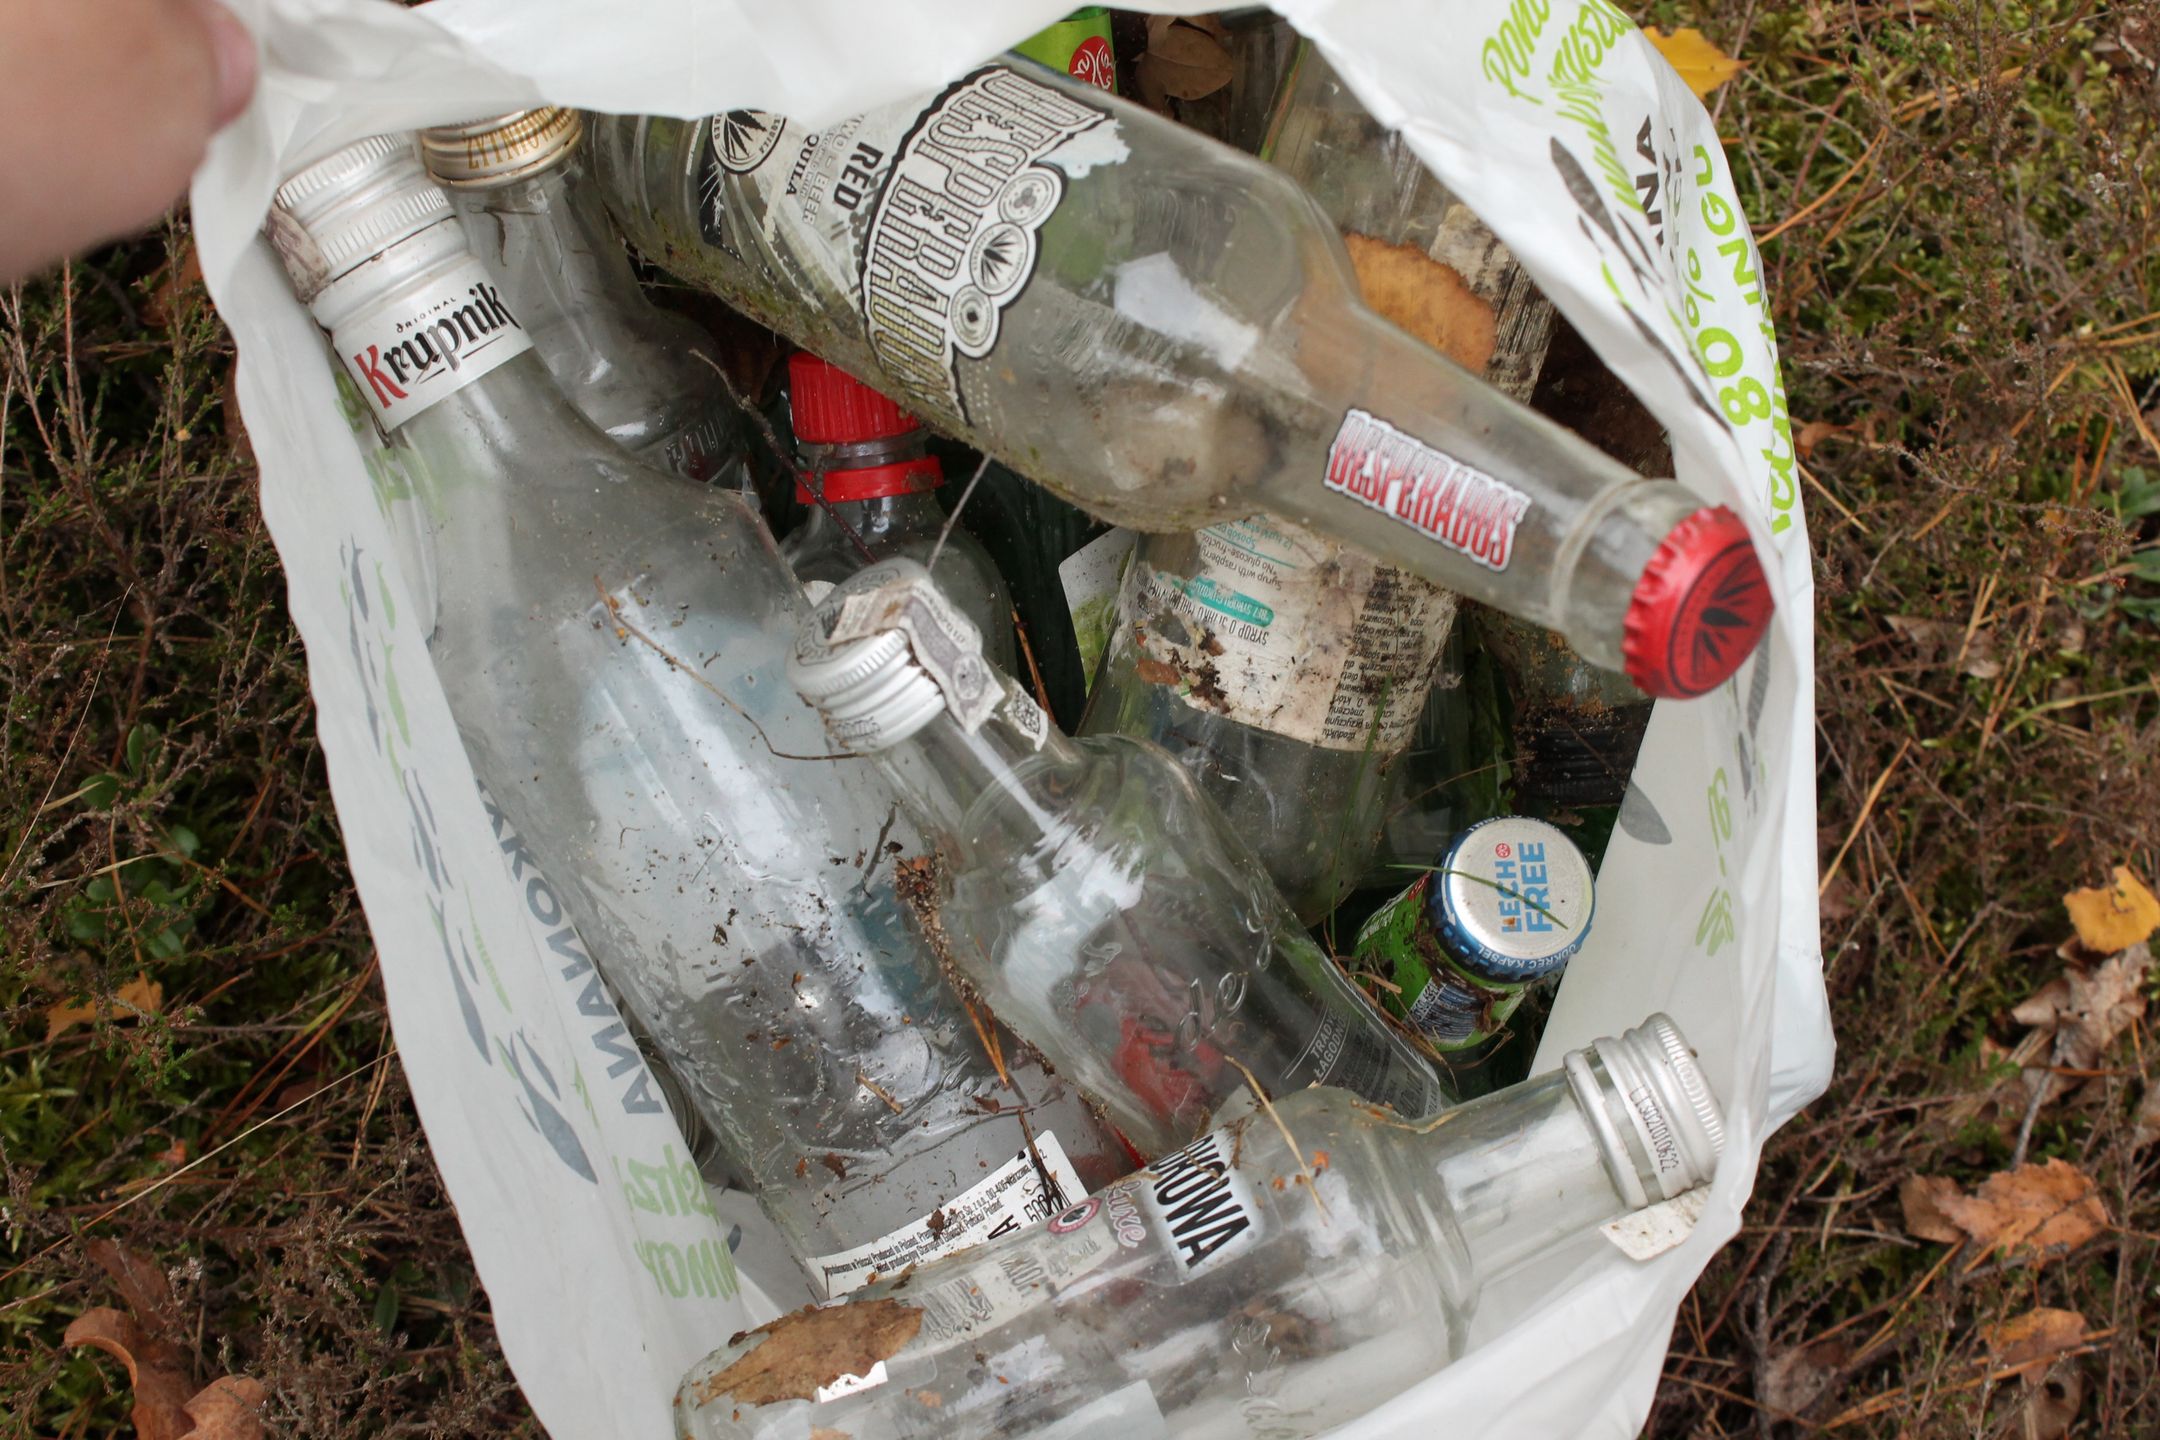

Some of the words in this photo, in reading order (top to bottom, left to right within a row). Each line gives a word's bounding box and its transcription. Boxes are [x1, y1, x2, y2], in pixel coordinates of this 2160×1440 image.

[801, 172, 830, 226] BEER
[831, 141, 884, 212] RED
[352, 281, 523, 409] Krupnik
[1682, 247, 1772, 427] 80%
[1326, 413, 1531, 568] DESPERADOS
[1199, 547, 1238, 572] raspberry
[1236, 566, 1257, 580] with
[1256, 571, 1284, 591] Syrup
[1228, 619, 1238, 634] O
[1237, 622, 1270, 646] SYROP
[1496, 860, 1522, 933] LECH
[1519, 841, 1554, 932] FREE
[1477, 944, 1525, 968] KAPSEL
